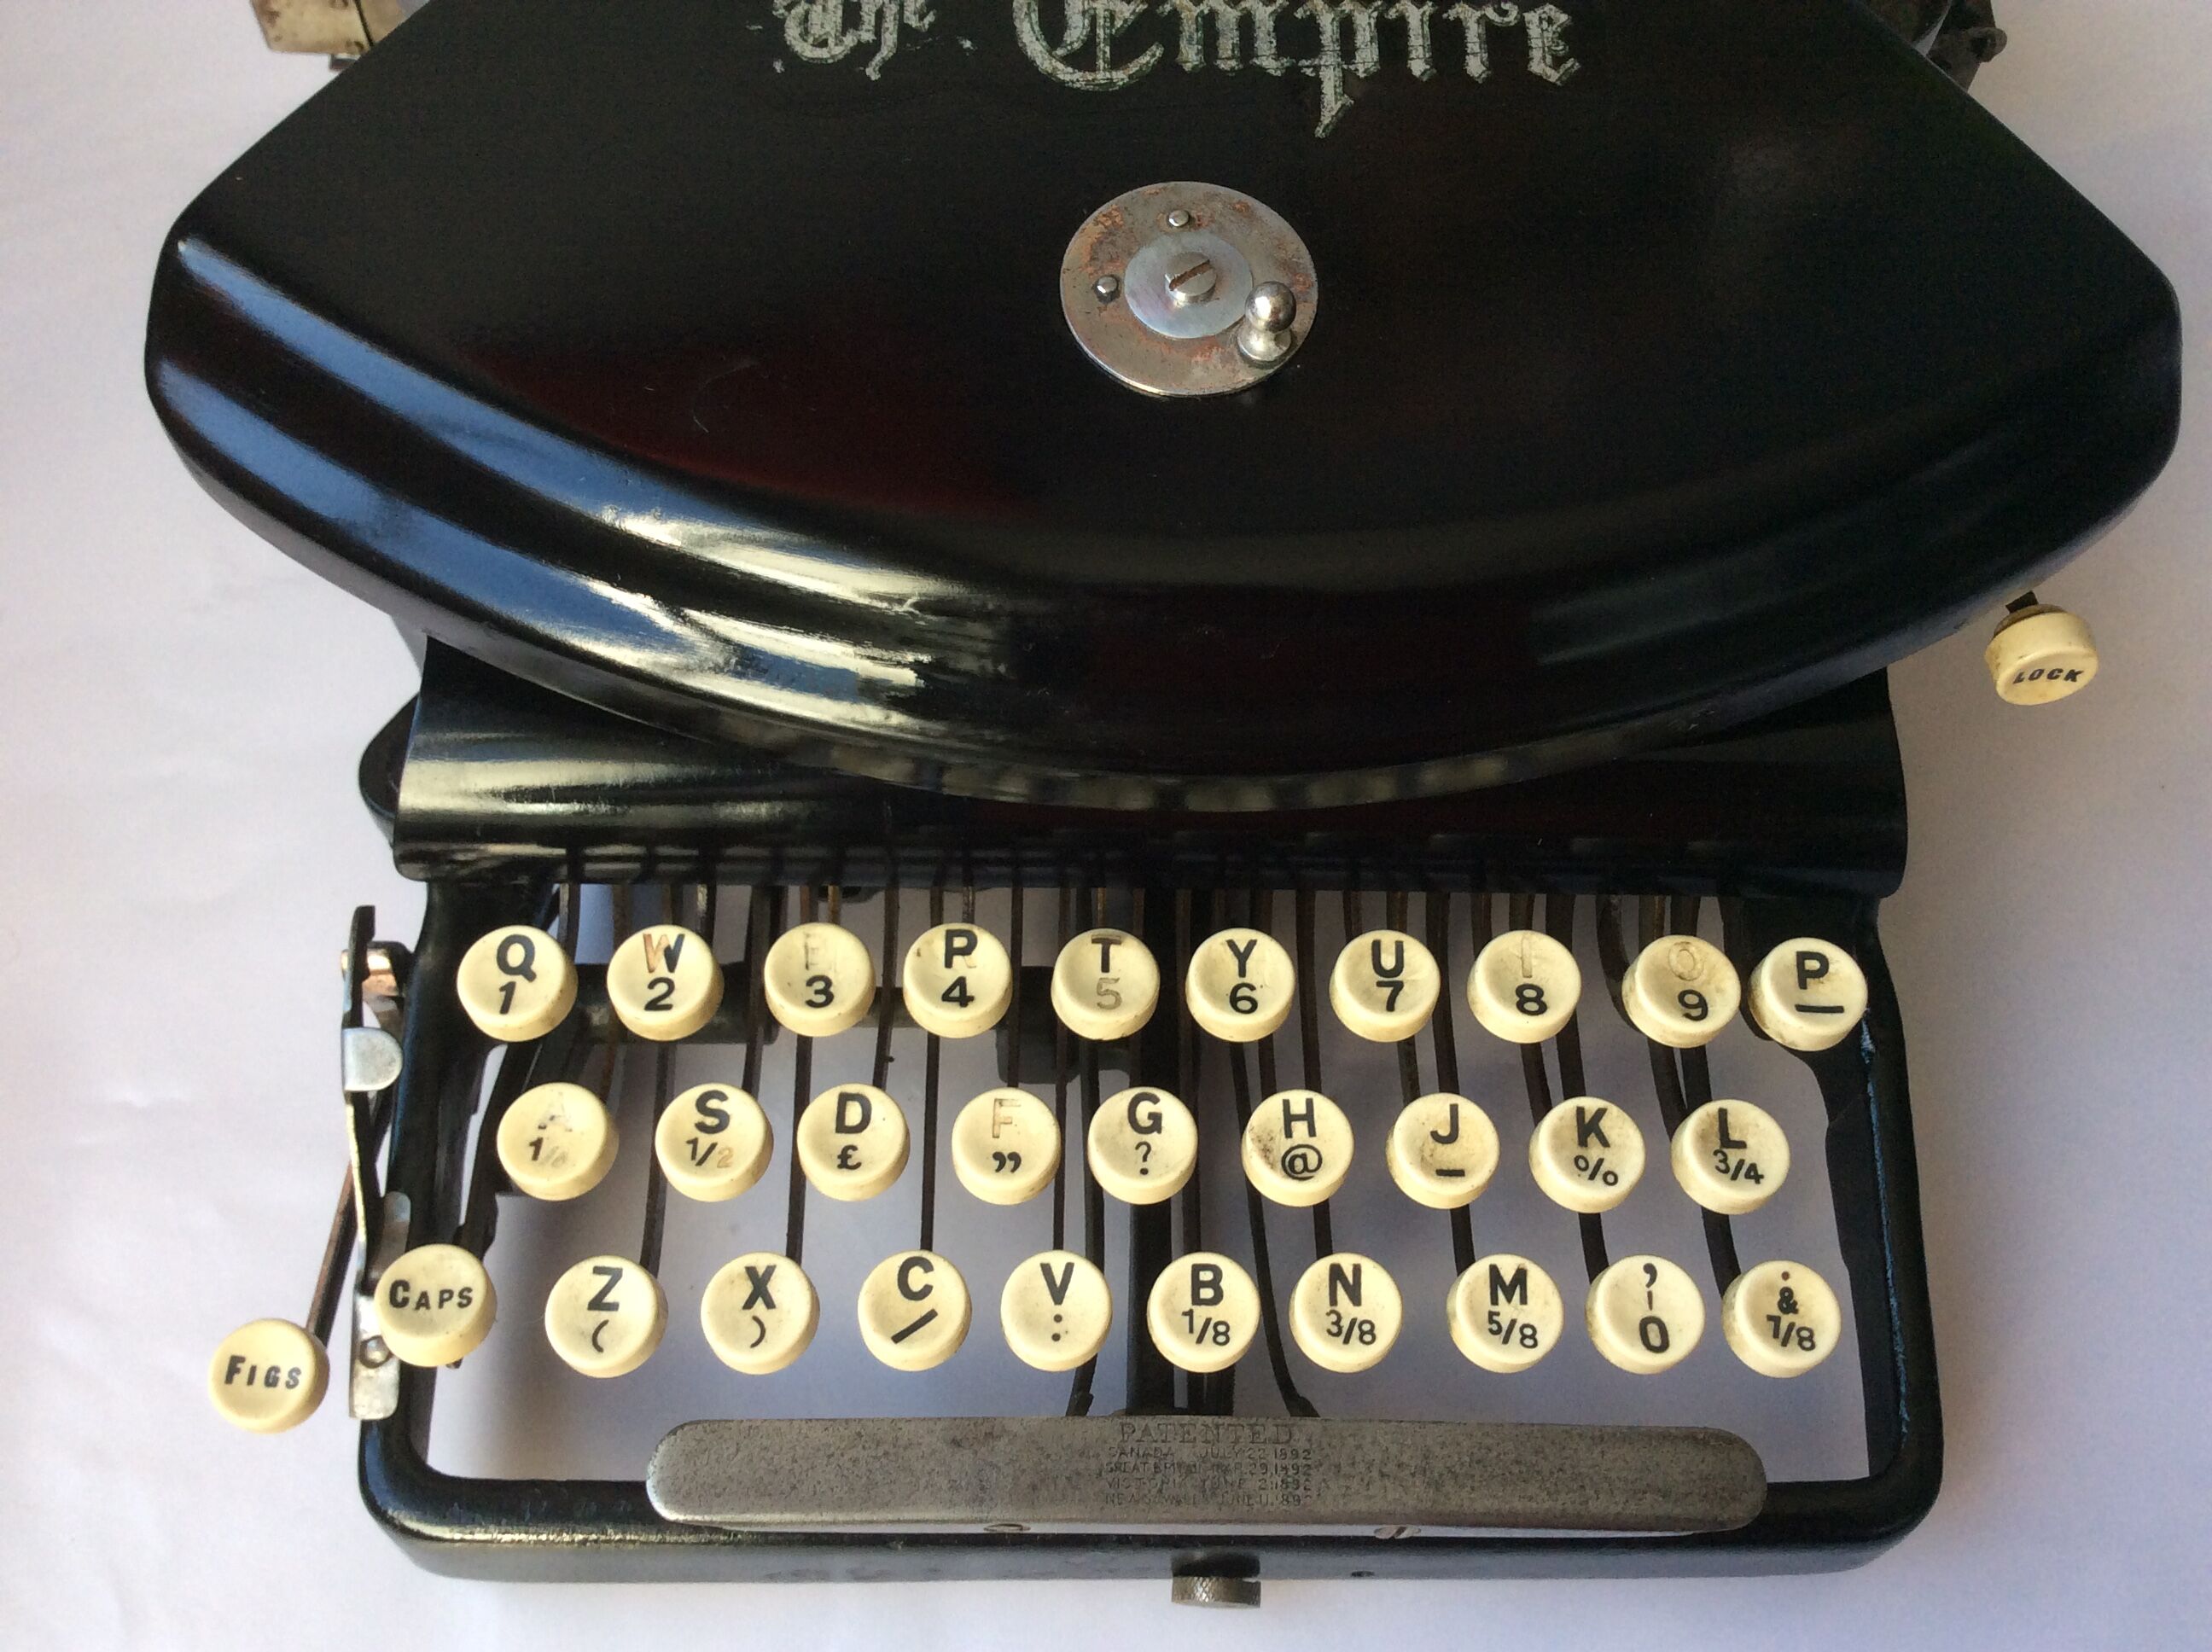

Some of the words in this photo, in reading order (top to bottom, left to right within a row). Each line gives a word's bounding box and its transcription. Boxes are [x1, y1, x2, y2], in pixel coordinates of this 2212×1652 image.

[2012, 668, 2085, 684] LOCK
[497, 934, 536, 982] Q
[643, 933, 685, 974] W
[1091, 934, 1122, 973] T
[1225, 939, 1258, 979] Y
[1371, 939, 1405, 979] U
[1668, 941, 1704, 982] O
[1795, 951, 1830, 991] P
[499, 981, 516, 1015] 1
[644, 977, 675, 1011] 2
[805, 974, 835, 1009] 3
[941, 975, 975, 1008] 4
[1096, 978, 1123, 1010] 5
[1229, 982, 1259, 1015] 6
[1377, 980, 1405, 1012] 7
[1515, 984, 1548, 1016] 8
[1677, 989, 1708, 1021] 9
[695, 1090, 731, 1135] S
[835, 1091, 873, 1135] D
[992, 1098, 1022, 1139] F
[1127, 1091, 1163, 1135] G
[1282, 1098, 1317, 1139] H
[1430, 1103, 1460, 1145] J
[1575, 1106, 1611, 1149] K
[1717, 1108, 1748, 1150] L
[685, 1137, 734, 1169] 1/2
[836, 1145, 862, 1171] £
[1135, 1142, 1152, 1176] ?
[1281, 1144, 1323, 1181] @
[1574, 1155, 1620, 1187] %
[1712, 1149, 1766, 1185] 3/4
[587, 1265, 624, 1312] Z
[742, 1264, 777, 1311] X
[896, 1255, 934, 1302] C
[1039, 1261, 1075, 1306] V
[1189, 1263, 1225, 1307] B
[1328, 1262, 1362, 1308] N
[1488, 1263, 1528, 1307] M
[1777, 1286, 1799, 1315] &
[591, 1320, 609, 1354] (
[749, 1315, 766, 1349] )
[1180, 1307, 1231, 1347] 1/8
[1324, 1309, 1377, 1347] 3/8
[1487, 1311, 1539, 1349] 5/8
[1766, 1314, 1816, 1352] 7/8
[1120, 1422, 1295, 1445] PATENTED
